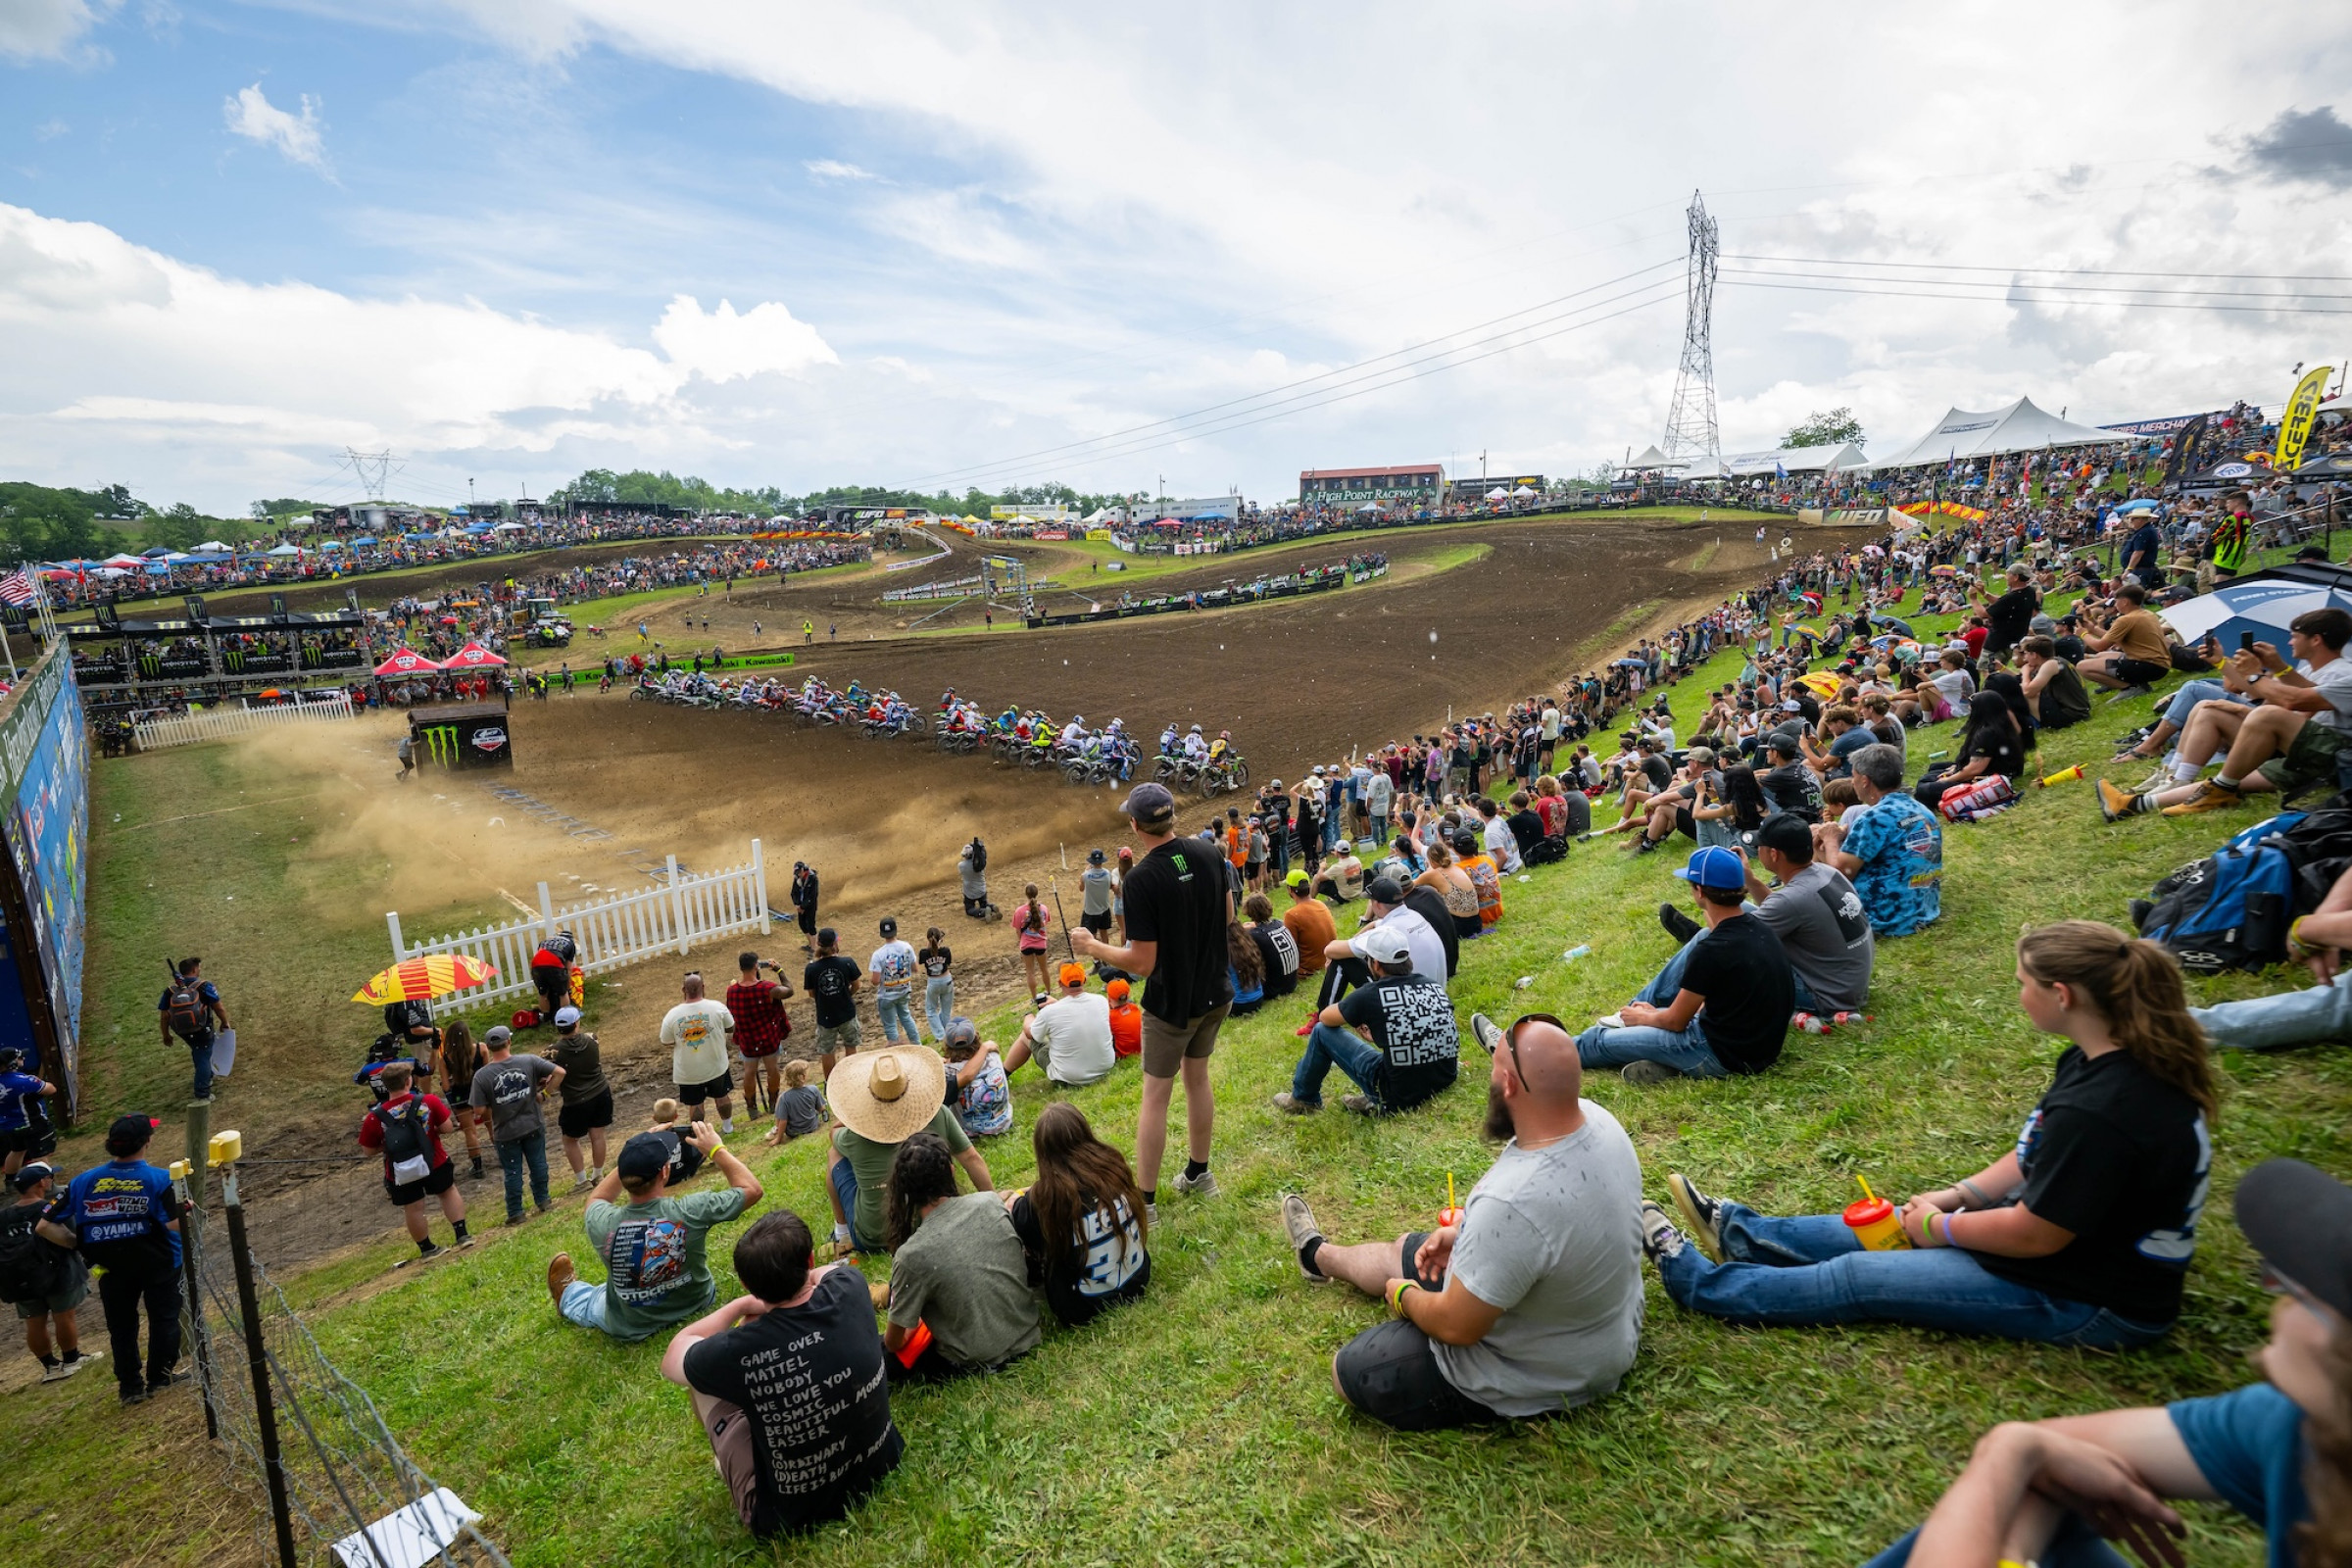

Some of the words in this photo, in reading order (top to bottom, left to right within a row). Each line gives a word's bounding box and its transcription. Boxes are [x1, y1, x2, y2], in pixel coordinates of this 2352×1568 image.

[1317, 491, 1343, 501] HIGH
[1344, 490, 1373, 501] POINT
[1374, 488, 1419, 500] RACEWAY
[1837, 510, 1884, 523] UFO
[745, 656, 791, 666] Kawasaki
[103, 1221, 144, 1235] YAMAHA
[740, 1348, 781, 1367] GAME
[788, 1331, 825, 1352] OVER
[744, 1354, 809, 1385] MATTEL
[750, 1369, 813, 1399] NOBODY
[756, 1400, 777, 1413] WE
[783, 1384, 822, 1407] LOVE
[823, 1367, 853, 1389] YOU
[761, 1397, 826, 1422] COSMIC
[764, 1400, 851, 1437] BEAUTIFUL
[767, 1425, 830, 1448] EASIER
[778, 1482, 808, 1494] LIFE
[829, 1463, 851, 1483] BUT
